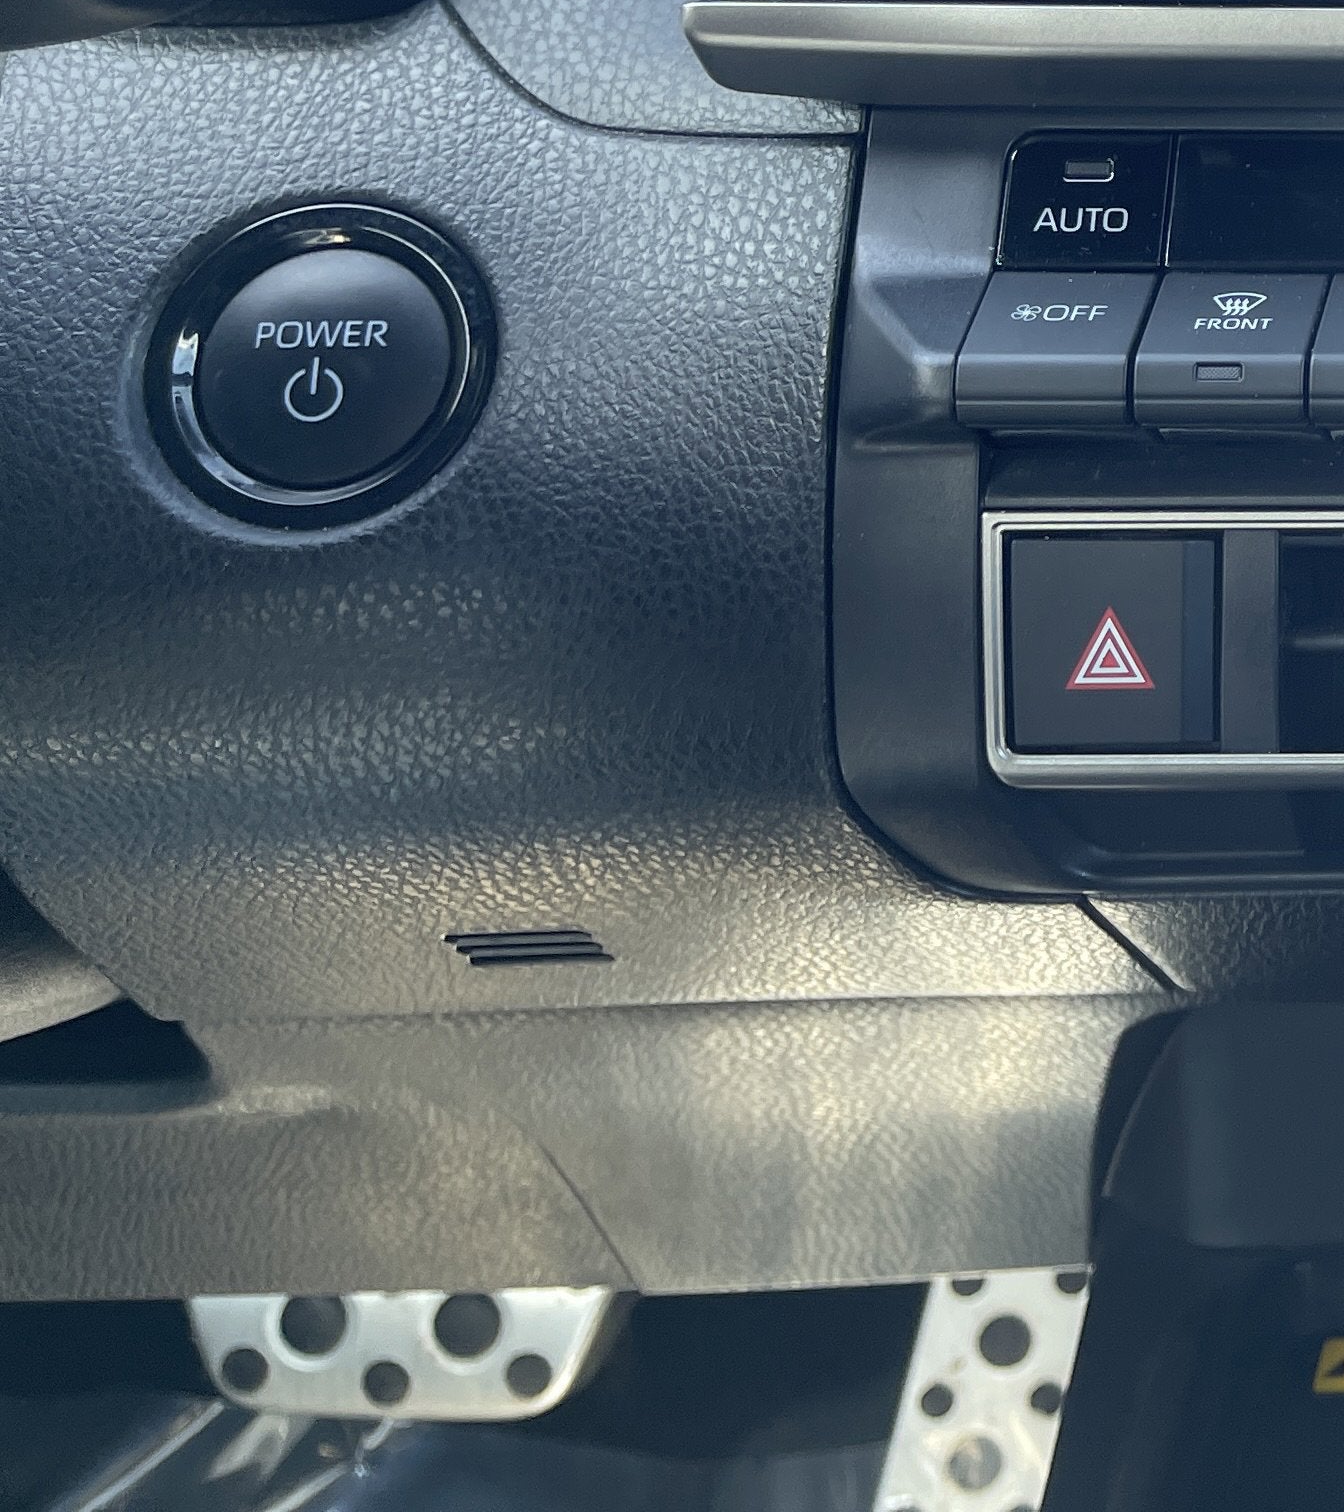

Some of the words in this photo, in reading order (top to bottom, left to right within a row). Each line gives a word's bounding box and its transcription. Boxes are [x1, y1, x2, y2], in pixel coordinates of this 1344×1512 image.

[1034, 207, 1128, 233] AUTO
[1043, 304, 1108, 322] OFF
[1194, 317, 1273, 330] FRONT
[255, 320, 388, 349] POWER
